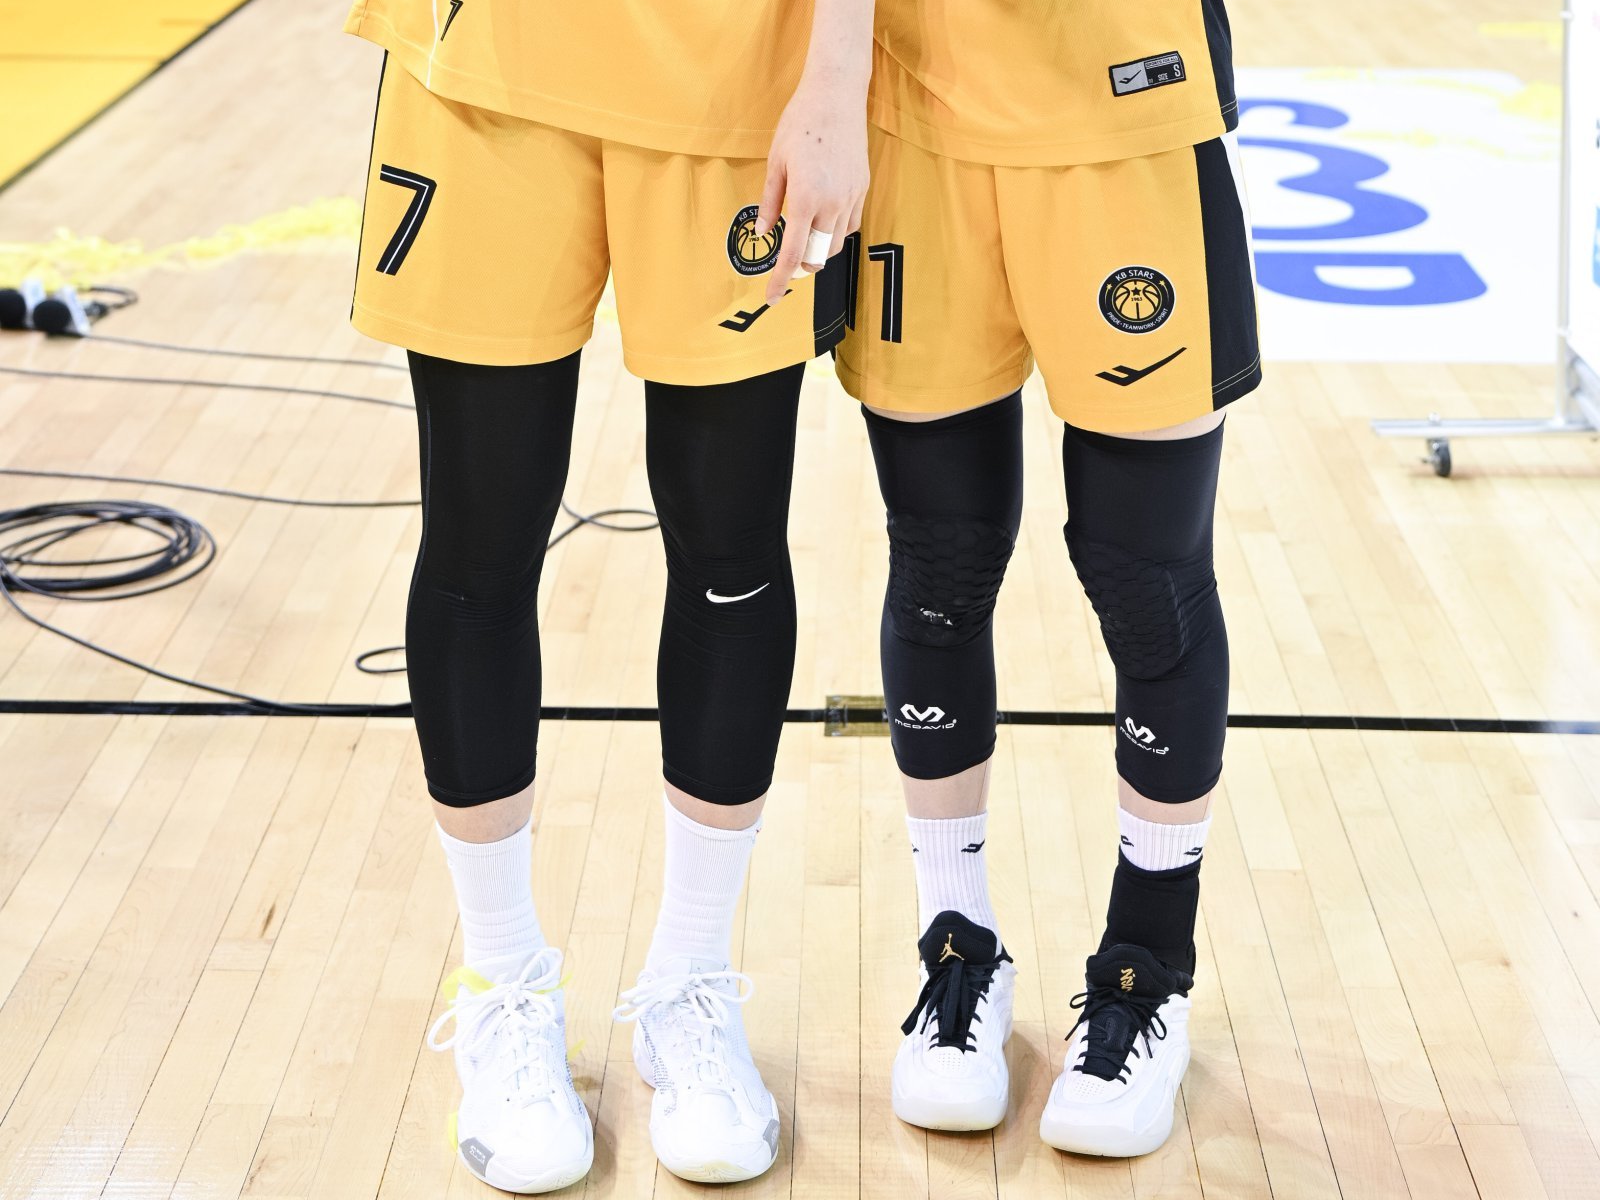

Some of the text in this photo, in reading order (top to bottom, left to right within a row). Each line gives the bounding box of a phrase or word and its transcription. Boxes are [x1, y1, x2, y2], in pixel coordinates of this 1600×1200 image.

[375, 163, 437, 276] 7
[738, 211, 748, 222] KB
[1115, 269, 1155, 282] KB STARS
[1107, 308, 1168, 330] PRIDE TEAMWORK SPIRIT
